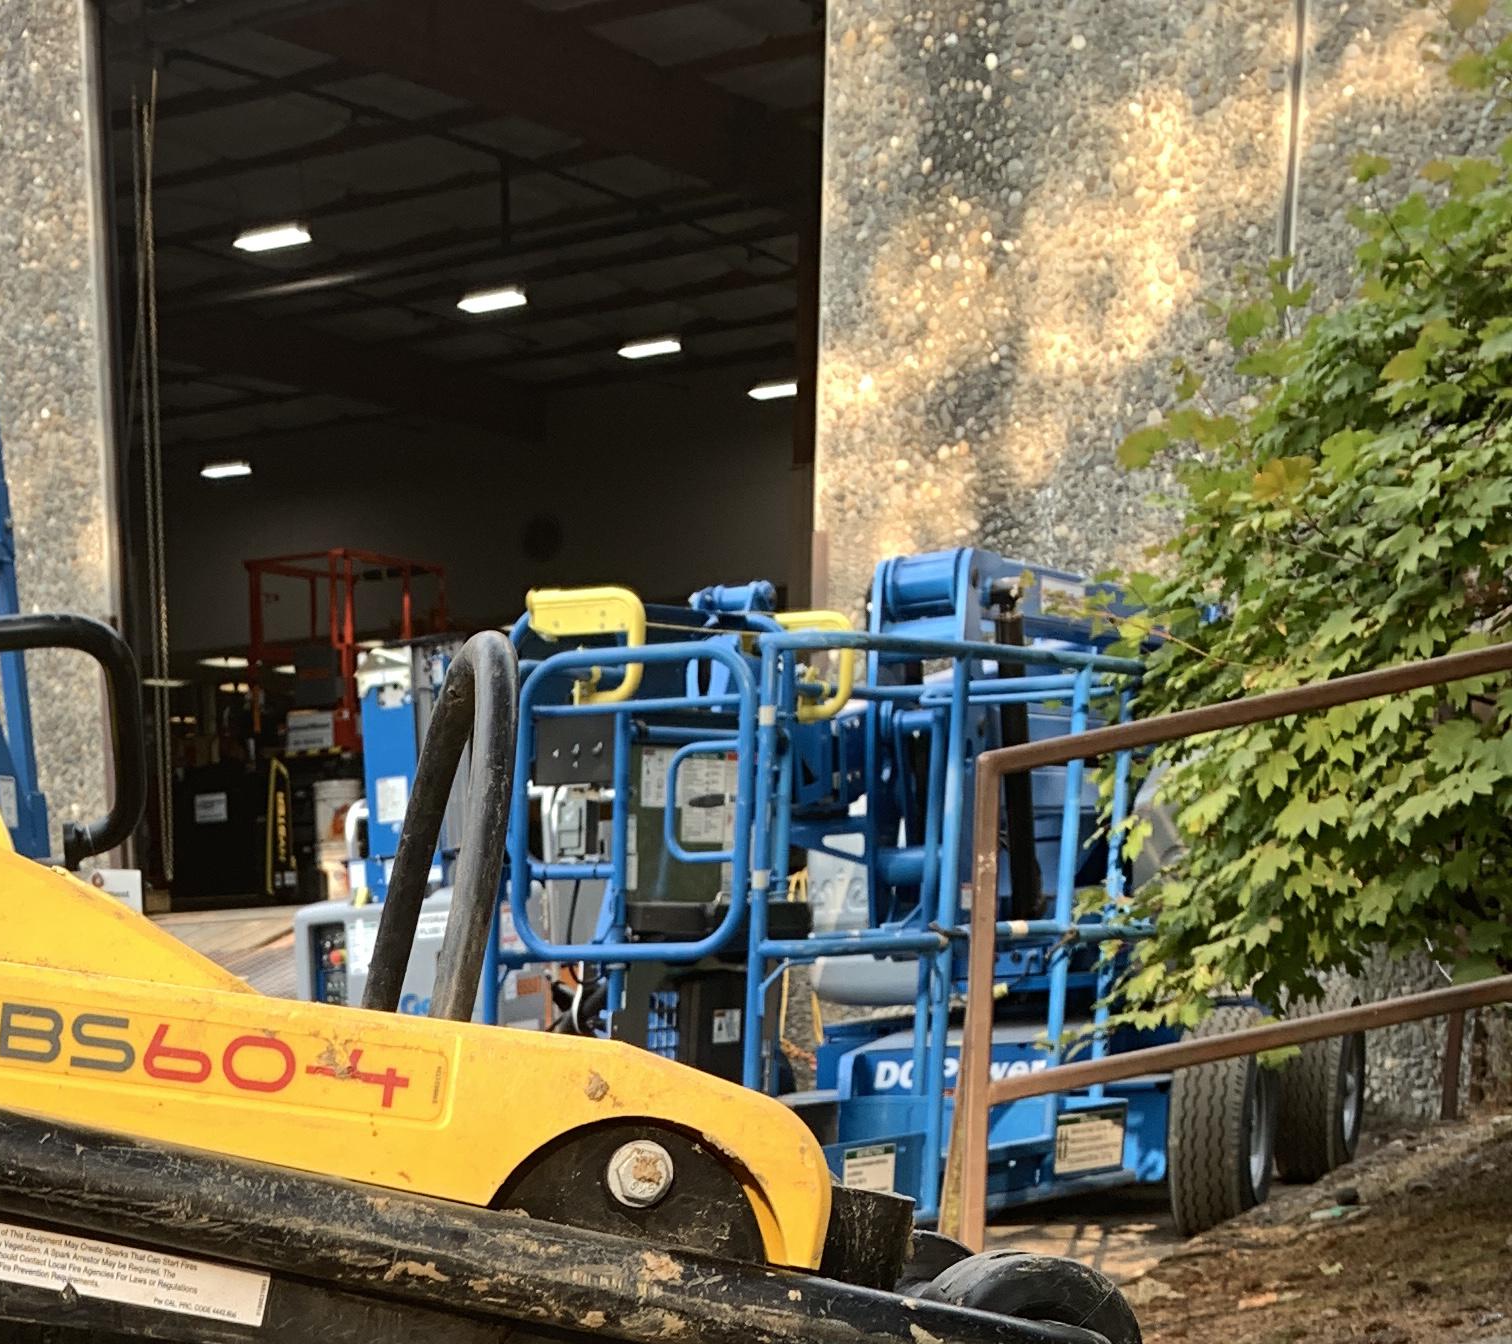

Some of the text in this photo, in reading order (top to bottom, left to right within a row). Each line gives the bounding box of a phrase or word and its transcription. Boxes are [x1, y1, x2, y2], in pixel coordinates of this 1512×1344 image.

[0, 1228, 8, 1236] of
[10, 1229, 24, 1239] This
[25, 1232, 62, 1246] Equipment
[63, 1239, 78, 1250] May
[80, 1242, 104, 1253] Create
[104, 1248, 128, 1259] Sparks
[129, 1252, 145, 1261] That
[146, 1255, 161, 1264] Can
[162, 1258, 179, 1267] Start
[180, 1261, 198, 1271] Fires
[50, 1249, 71, 1260] Spark
[72, 1253, 100, 1264] Arrestor
[101, 1258, 116, 1268] May
[117, 1261, 126, 1269] be
[127, 1262, 161, 1276] Required.
[162, 1268, 176, 1278] The
[12, 1265, 49, 1278] Prevention
[18, 1255, 46, 1266] Contact
[47, 1260, 66, 1270] Local
[68, 1263, 81, 1272] Fire
[82, 1266, 114, 1280] Agencies
[115, 1272, 127, 1281] For
[128, 1275, 147, 1285] Laws
[148, 1279, 155, 1287] or
[157, 1280, 198, 1295] Regulations
